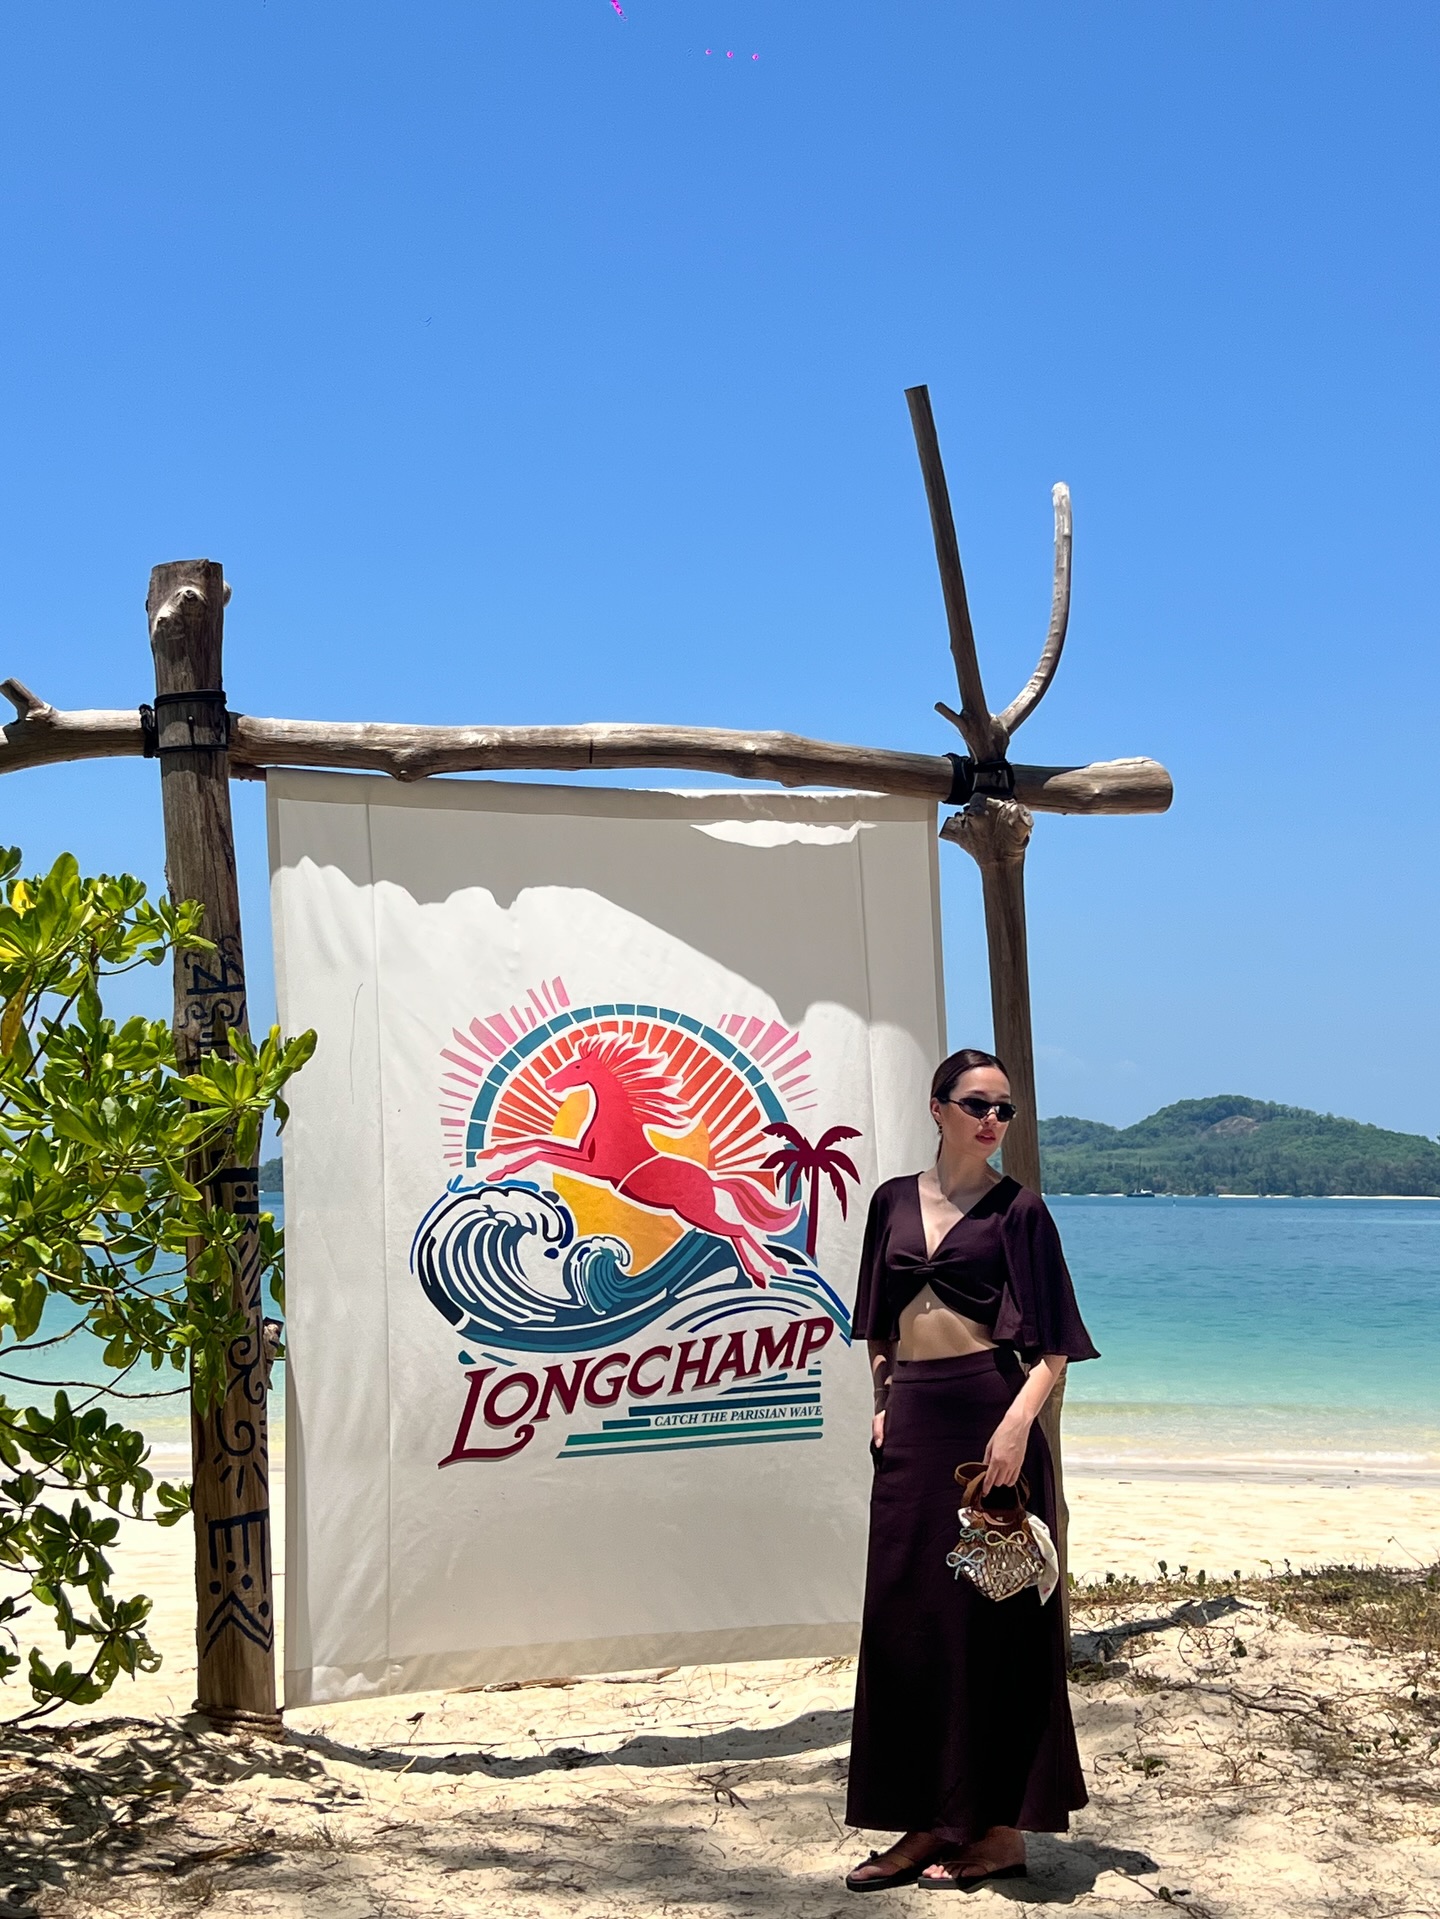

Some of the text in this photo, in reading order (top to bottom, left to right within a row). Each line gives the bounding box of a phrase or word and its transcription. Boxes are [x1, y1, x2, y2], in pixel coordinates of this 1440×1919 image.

[438, 1316, 835, 1469] LONGCHAMP
[654, 1405, 823, 1426] CATCH THE PARISIAN WAVE
